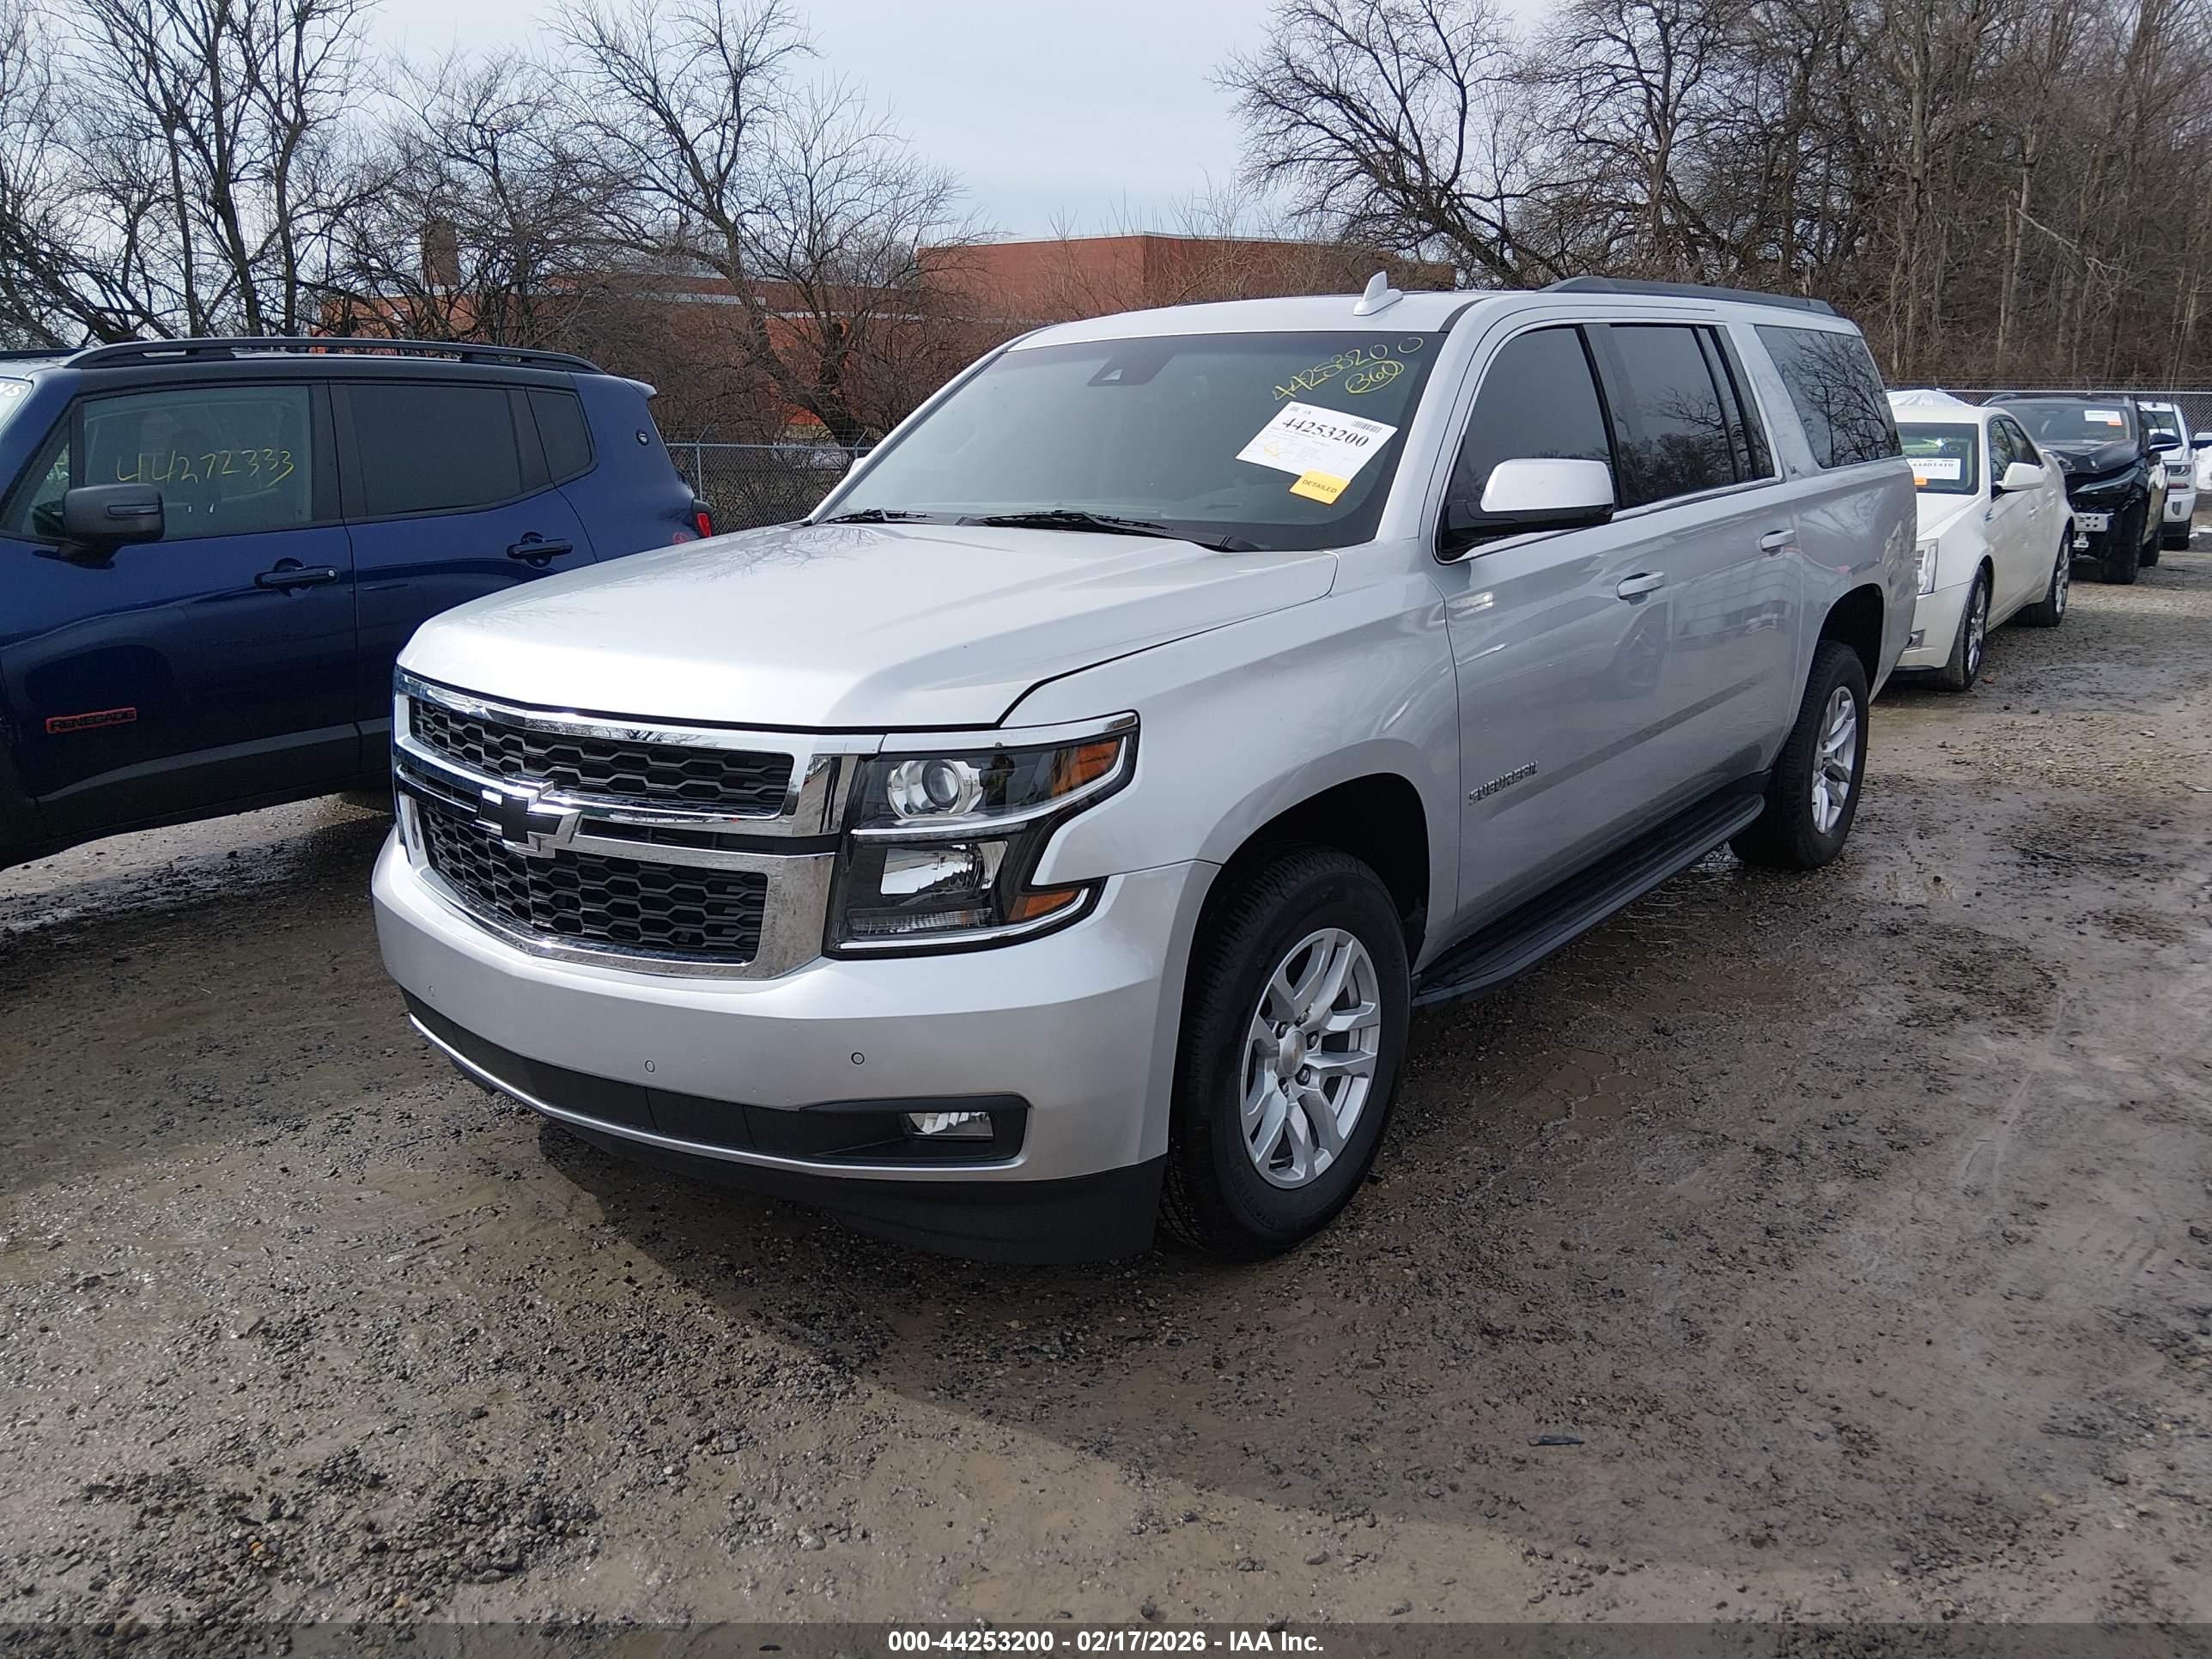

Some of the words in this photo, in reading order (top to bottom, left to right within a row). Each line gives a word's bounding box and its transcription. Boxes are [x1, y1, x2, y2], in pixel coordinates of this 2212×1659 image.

[1271, 337, 1424, 401] 44253200
[1346, 361, 1400, 393] 360
[1282, 417, 1370, 447] 44253200
[116, 448, 295, 487] 44272333
[1302, 479, 1338, 494] DETAILED
[51, 710, 136, 730] RENEGADE
[1468, 760, 1539, 803] SUBURBAN
